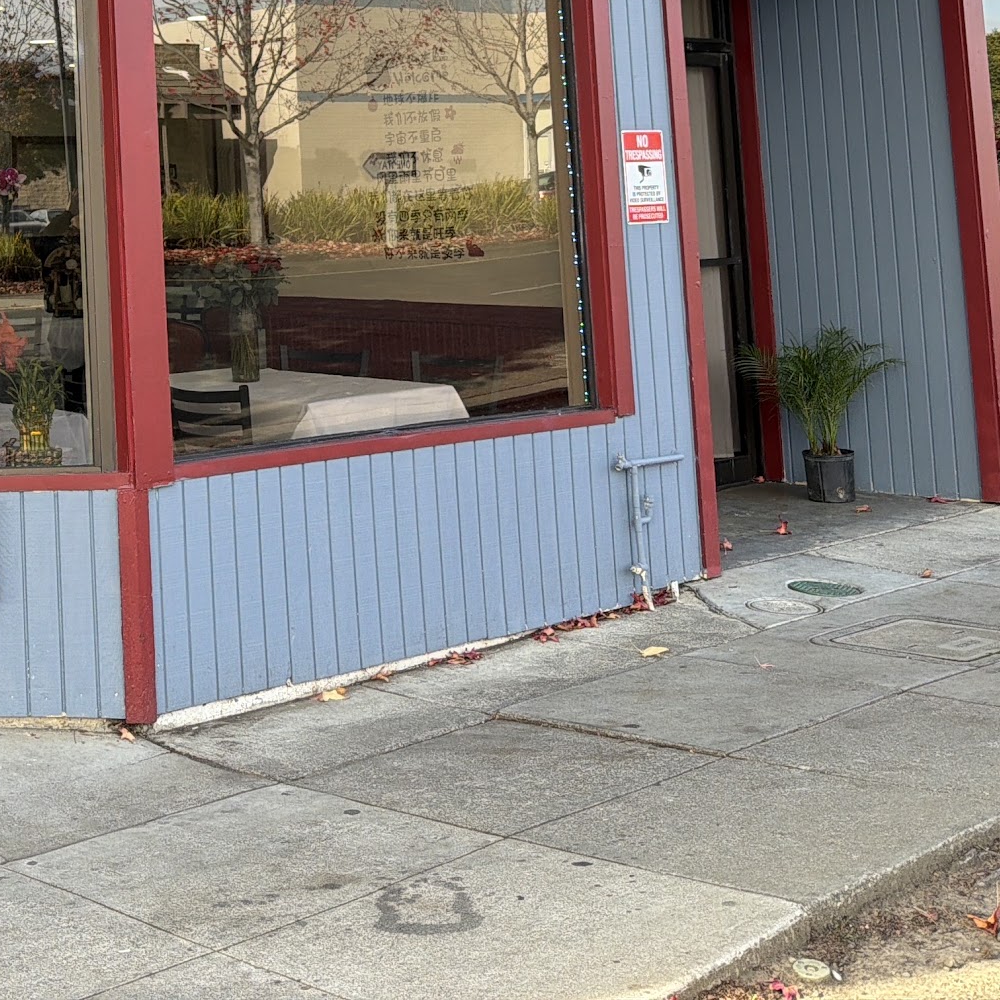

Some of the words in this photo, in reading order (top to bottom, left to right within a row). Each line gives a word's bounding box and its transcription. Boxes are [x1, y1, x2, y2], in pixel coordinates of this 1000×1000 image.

[383, 108, 441, 126] 我们不放假
[384, 127, 442, 146] 宇宙不重启
[636, 134, 648, 148] NO
[625, 149, 663, 161] TRESPASSING
